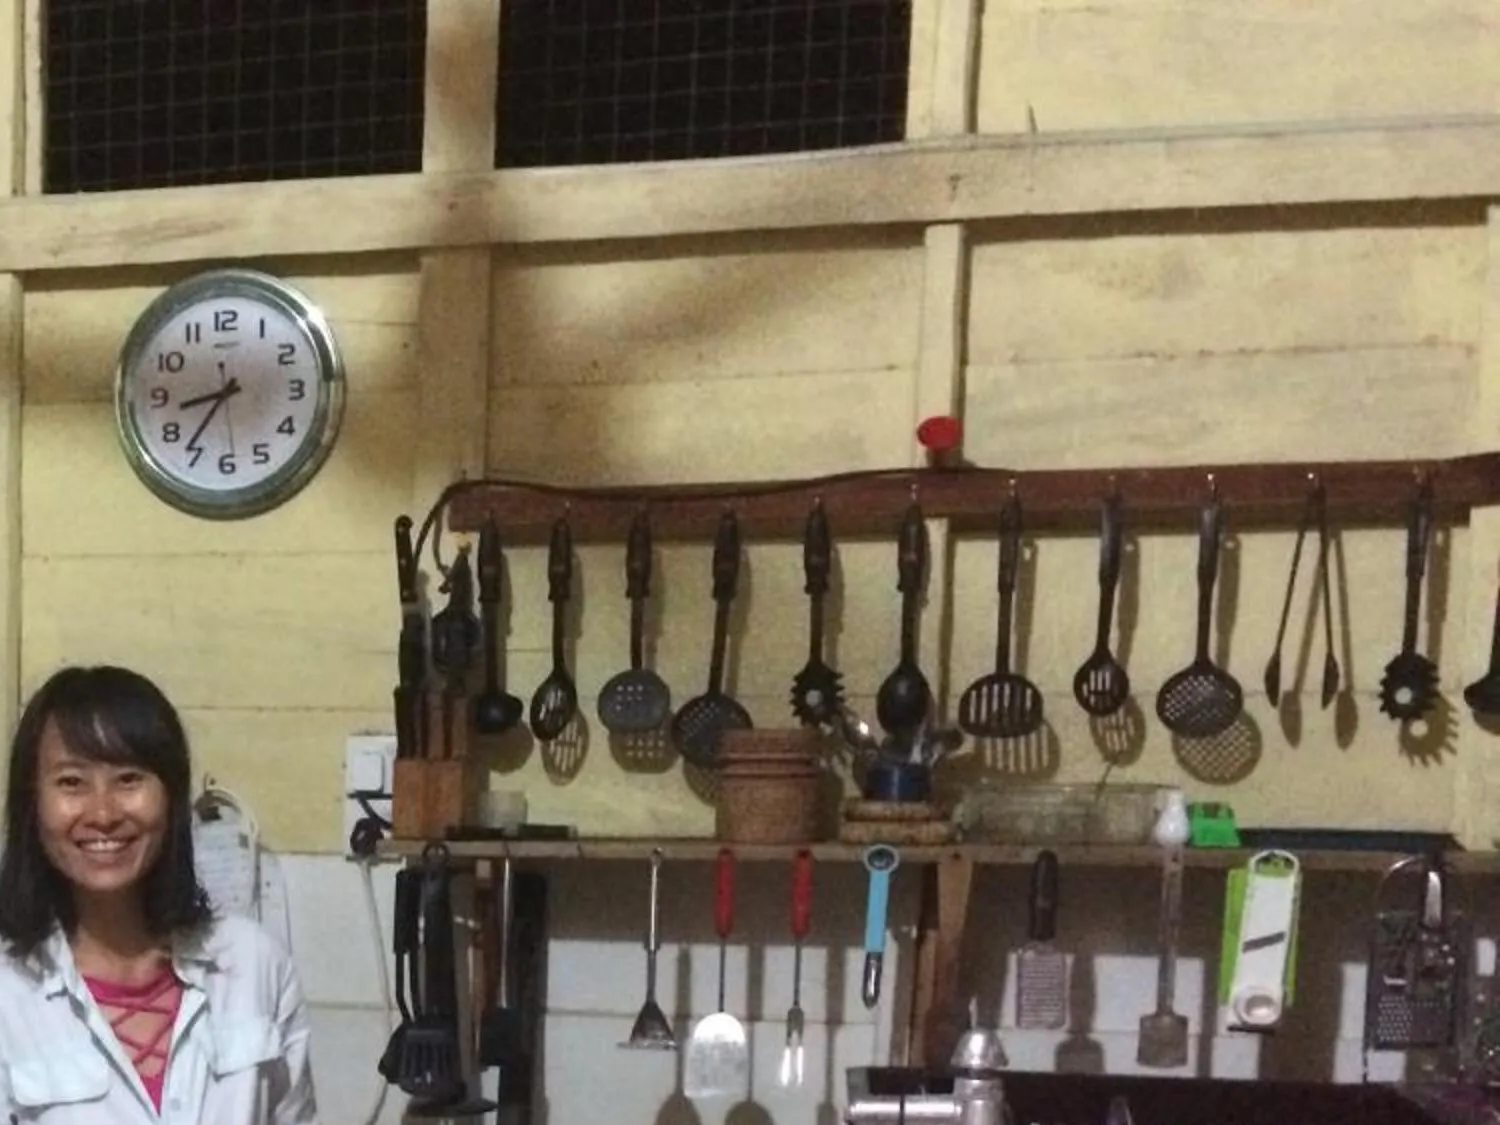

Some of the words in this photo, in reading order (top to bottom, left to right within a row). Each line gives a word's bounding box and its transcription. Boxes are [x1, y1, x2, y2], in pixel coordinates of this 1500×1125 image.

[214, 310, 238, 332] 12
[259, 318, 265, 338] 1
[186, 323, 201, 344] 11
[158, 352, 184, 373] 10
[277, 344, 296, 366] 2
[151, 387, 169, 408] 9
[288, 380, 305, 400] 3
[162, 422, 180, 443] 8
[276, 416, 295, 436] 4
[187, 447, 204, 468] 7
[218, 453, 236, 475] 6
[253, 443, 271, 465] 5
